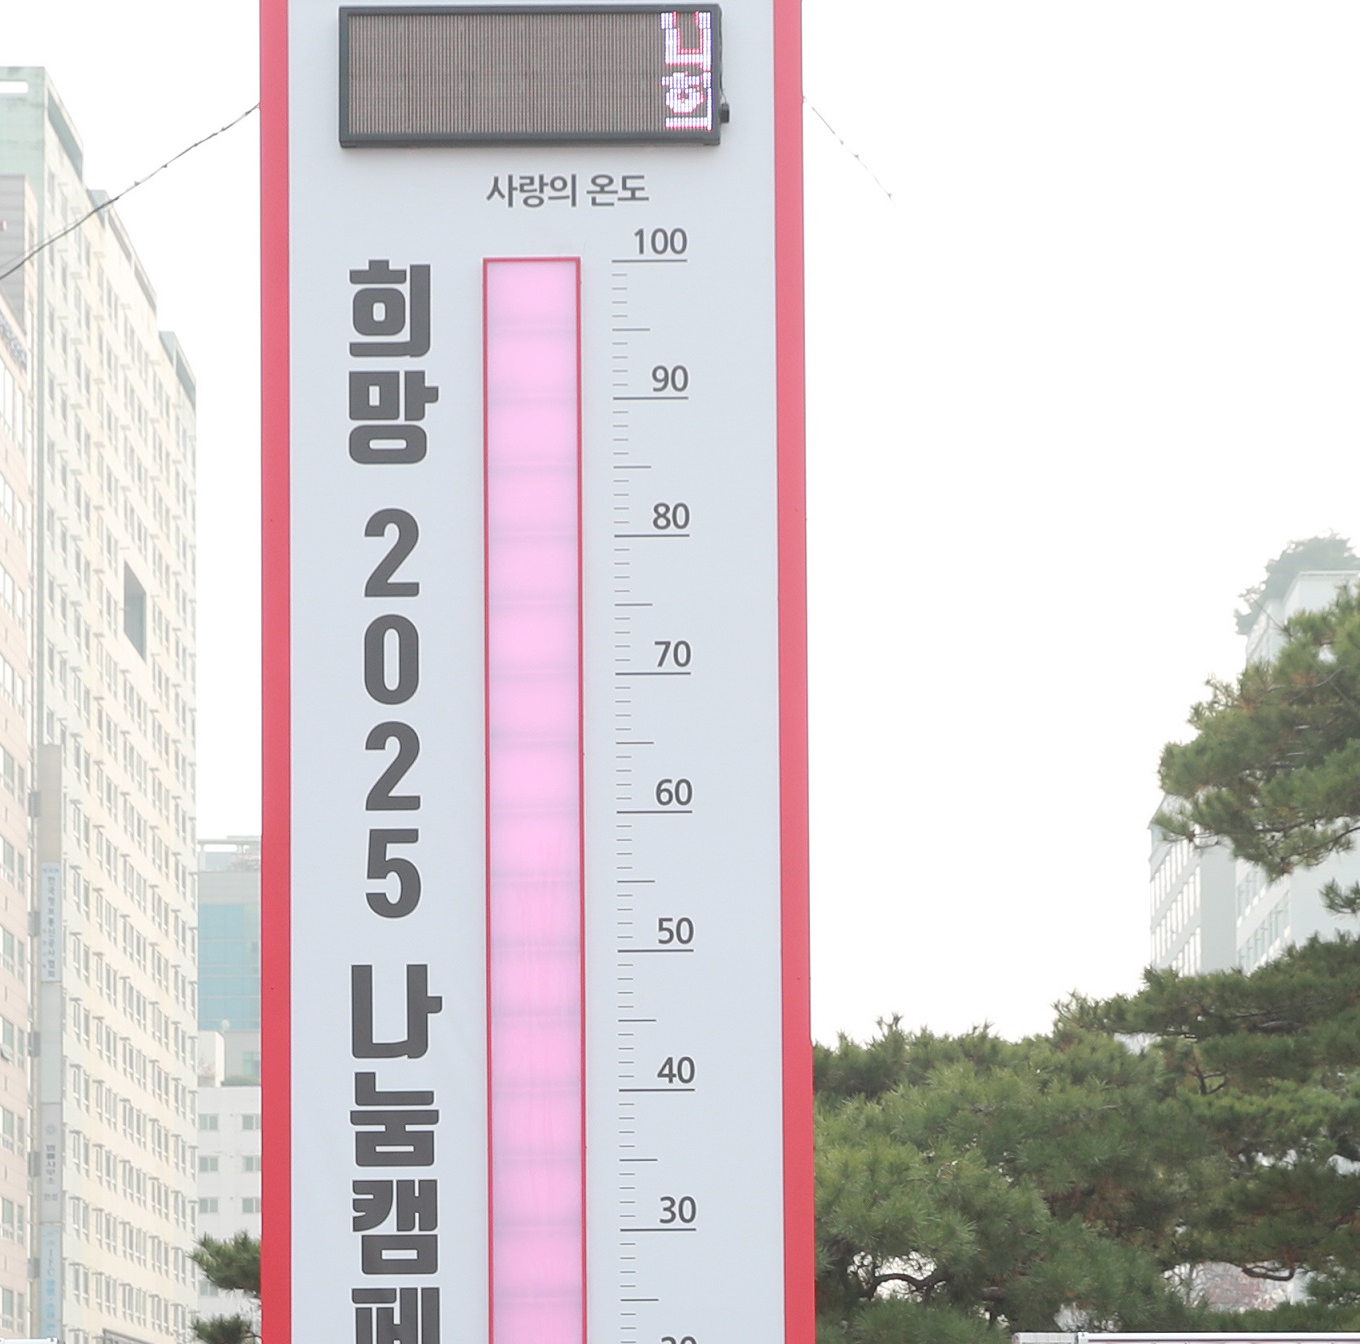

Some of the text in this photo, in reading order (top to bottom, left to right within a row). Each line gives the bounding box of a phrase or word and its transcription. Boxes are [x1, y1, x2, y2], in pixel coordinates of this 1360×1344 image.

[486, 173, 650, 208] 사랑의 온도
[632, 228, 688, 255] 100
[348, 258, 439, 465] 희망
[651, 365, 689, 392] 90
[652, 502, 690, 530] 80
[654, 640, 692, 668] 70
[363, 508, 422, 919] 2025
[655, 778, 693, 806] 60
[656, 917, 694, 945] 50
[657, 1056, 696, 1084] 40
[659, 1196, 697, 1224] 30
